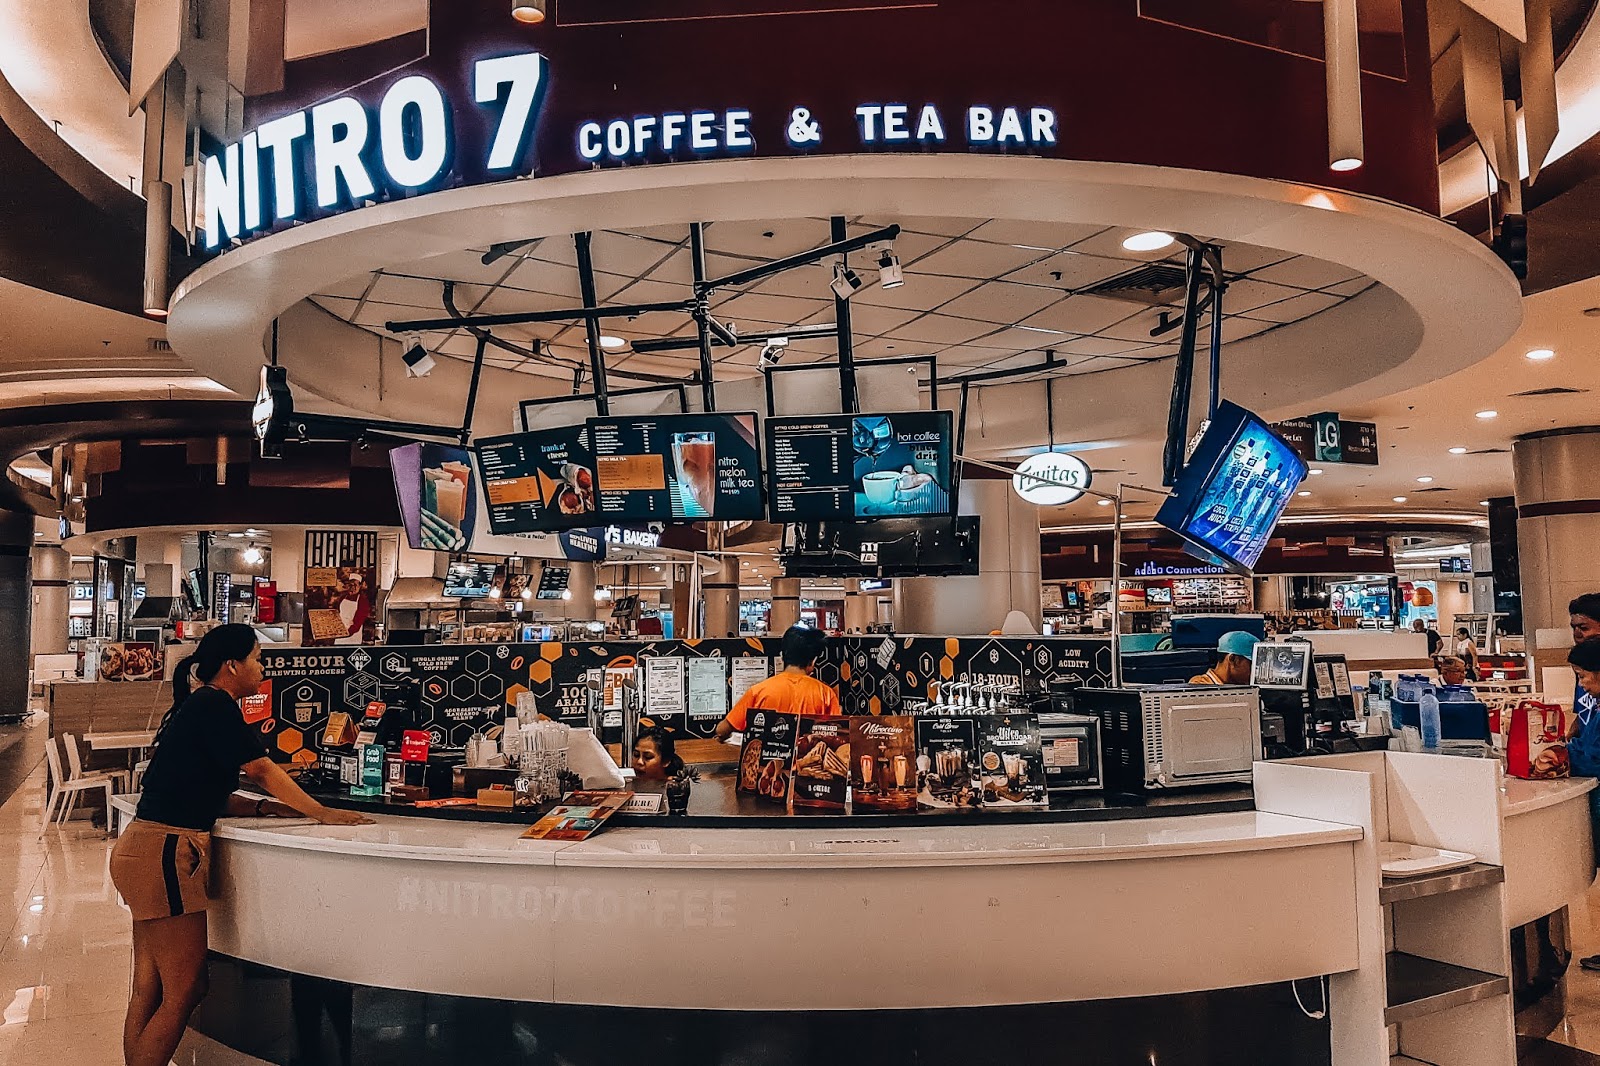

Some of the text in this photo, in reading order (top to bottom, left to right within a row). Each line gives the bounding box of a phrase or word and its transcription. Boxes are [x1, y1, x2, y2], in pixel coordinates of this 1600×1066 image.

[579, 105, 1056, 159] COFFEE & TEA BAR
[204, 52, 547, 250] NITRO 7
[897, 431, 940, 441] hot coffee
[1317, 421, 1338, 447] LG
[719, 466, 747, 477] melon
[720, 477, 755, 488] milk tea
[1208, 513, 1225, 524] JUICE
[623, 529, 659, 548] BAKERY
[1166, 565, 1225, 575] Connection
[1064, 649, 1081, 657] LOW
[264, 655, 346, 669] 18-HOUR
[1058, 660, 1090, 669] ACIDITY
[972, 673, 1020, 686] 18-HOUR
[561, 687, 587, 699] 100
[554, 698, 587, 708] ARAB
[561, 706, 586, 715] BEA
[859, 721, 904, 735] Nitroccino
[366, 748, 380, 756] Grab
[366, 755, 380, 763] Food
[514, 777, 530, 793] TIP
